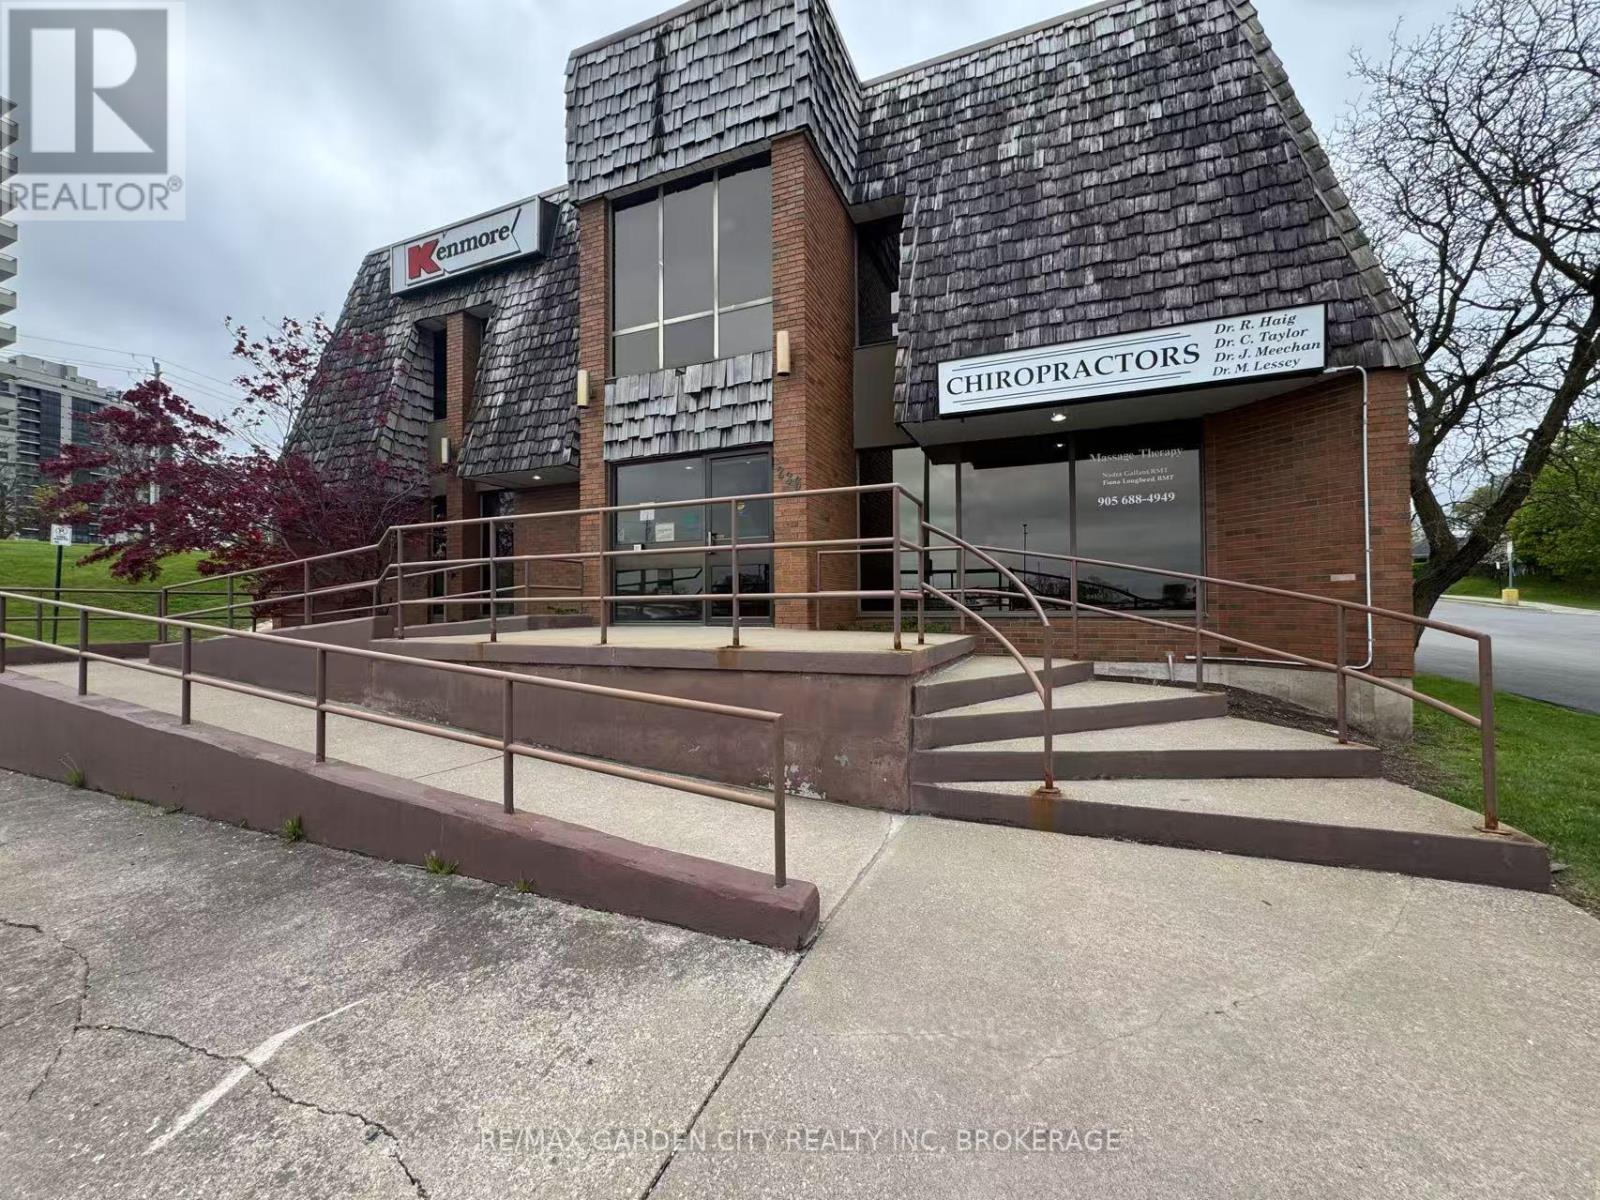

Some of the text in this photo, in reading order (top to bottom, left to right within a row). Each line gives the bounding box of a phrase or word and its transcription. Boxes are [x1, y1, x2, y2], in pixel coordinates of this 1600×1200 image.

[407, 225, 510, 280] Kenmore
[1214, 314, 1297, 335] Dr. R. Haig
[1214, 328, 1309, 349] Dr. C. Taylor
[1214, 341, 1321, 363] Dr. J. Meechan
[946, 342, 1200, 396] CHIROPRACTORS
[1212, 357, 1301, 377] Dr. M. Lessey
[1089, 447, 1184, 463] Massage Therapy
[1097, 491, 1176, 507] 905 688-4949
